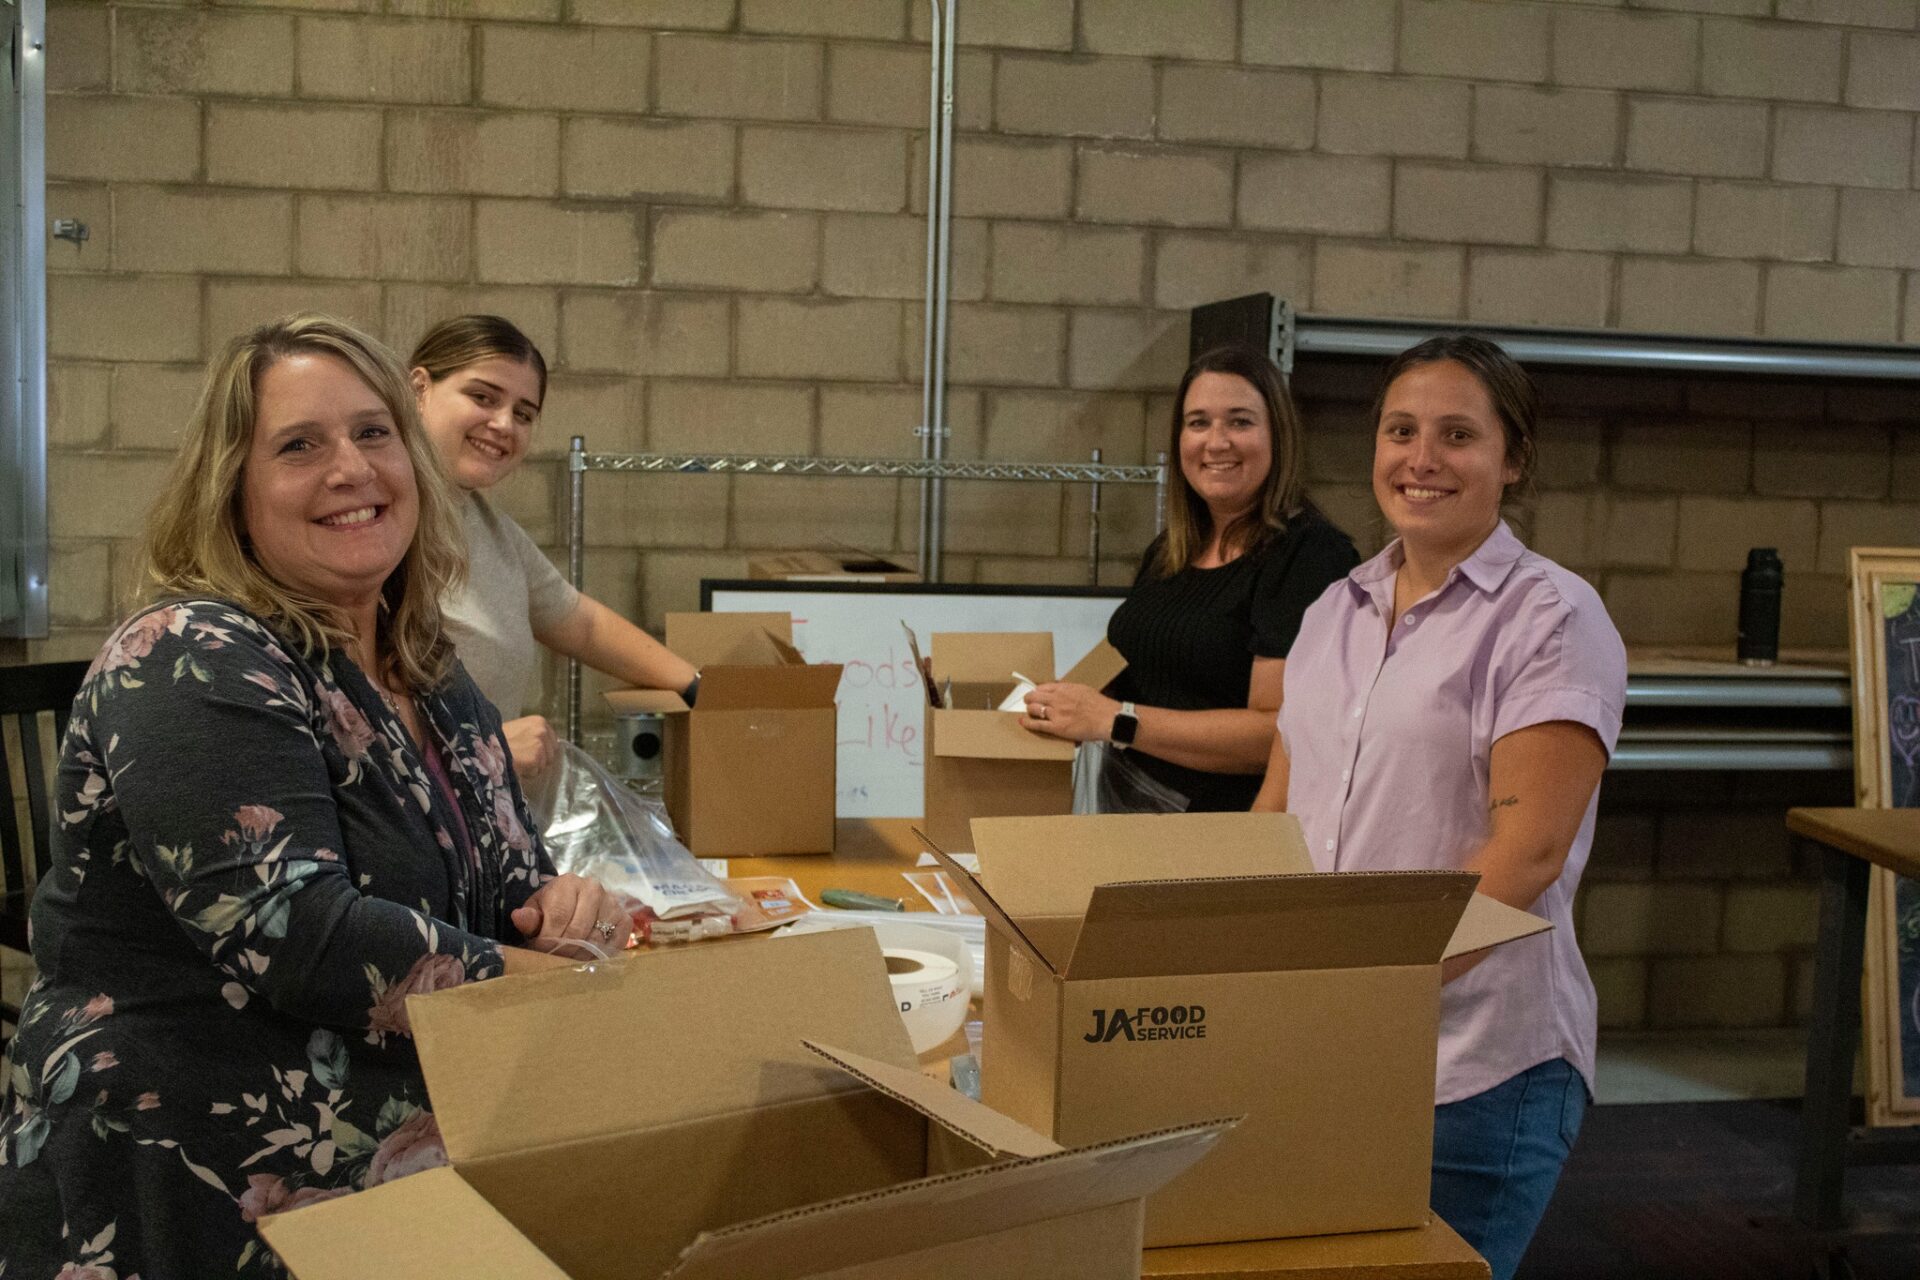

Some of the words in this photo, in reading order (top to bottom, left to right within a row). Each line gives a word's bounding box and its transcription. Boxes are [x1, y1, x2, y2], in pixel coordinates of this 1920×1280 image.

[843, 647, 919, 689] ods
[1083, 1008, 1137, 1043] JA
[1136, 1005, 1206, 1026] FOOD
[1137, 1025, 1206, 1041] SERVICE
